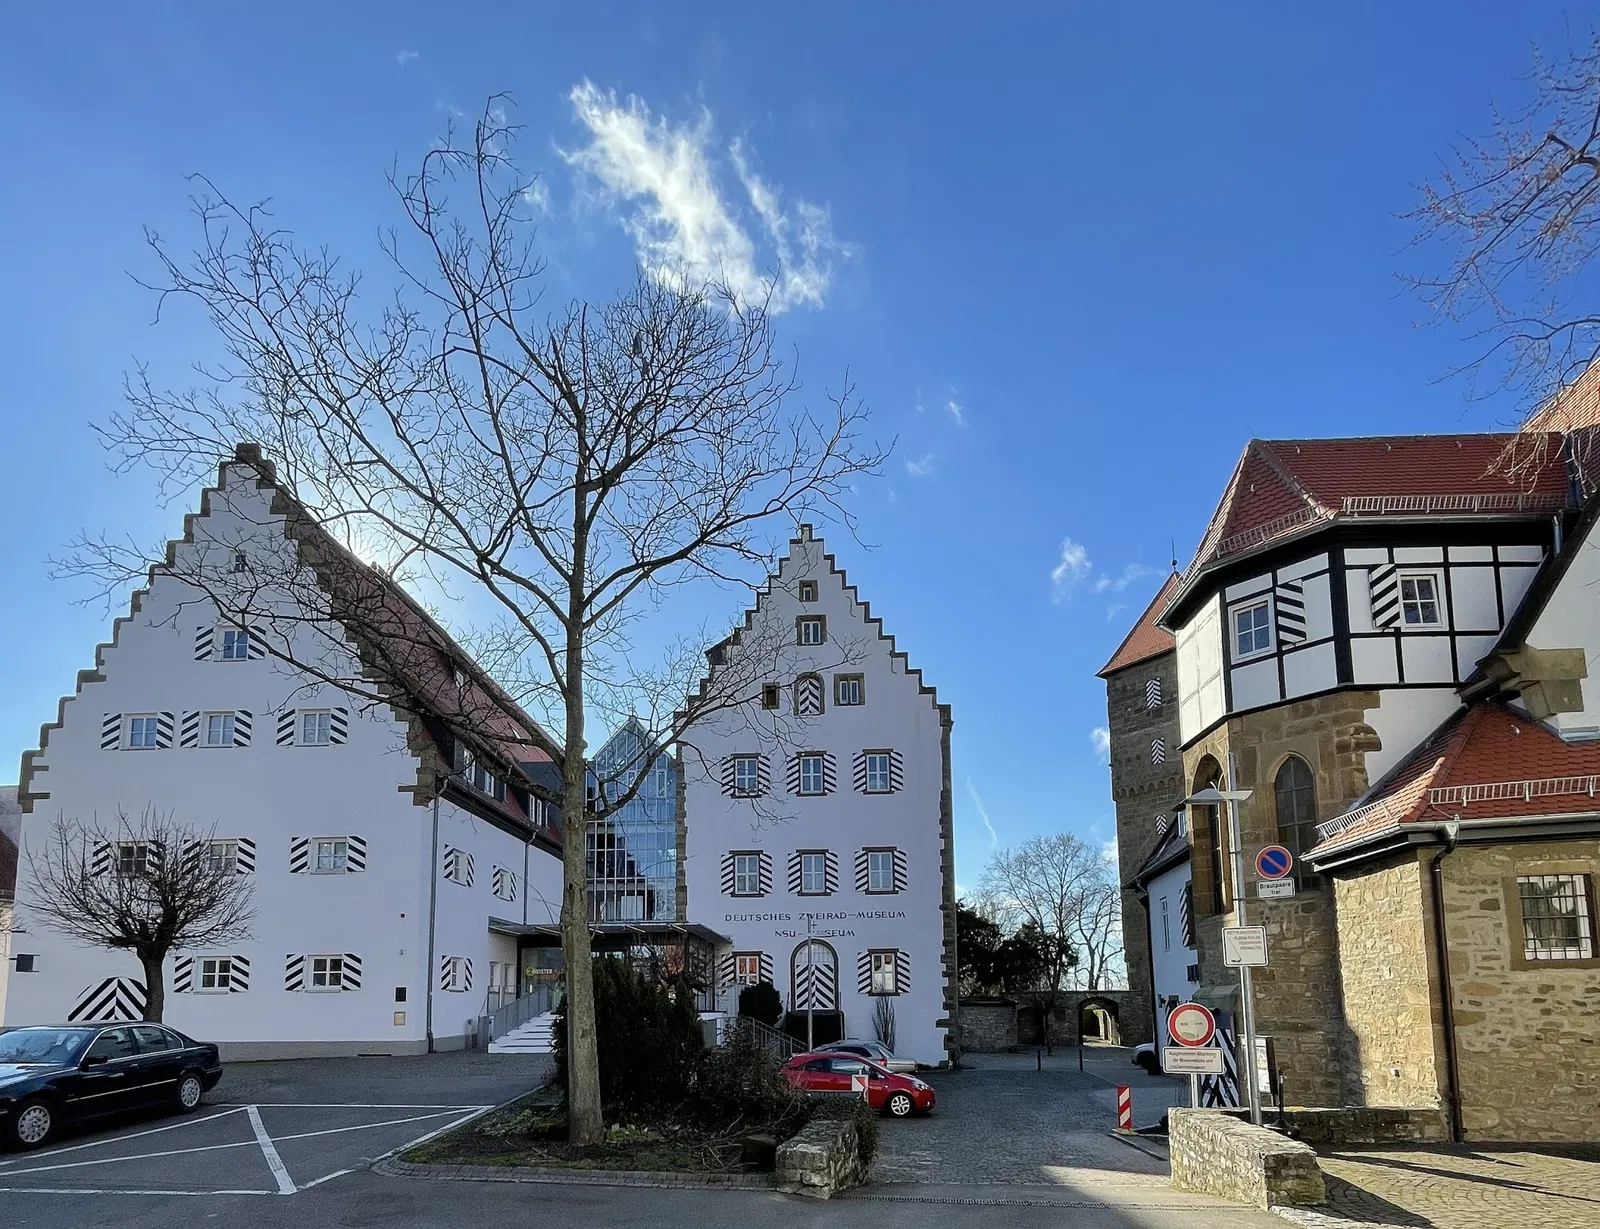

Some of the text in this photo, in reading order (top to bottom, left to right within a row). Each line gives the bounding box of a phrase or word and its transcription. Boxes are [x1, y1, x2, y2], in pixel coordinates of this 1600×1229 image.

[1259, 882, 1291, 890] Brautpaare
[724, 913, 792, 922] DEUTSCHES
[774, 929, 856, 938] NSU-SEUM
